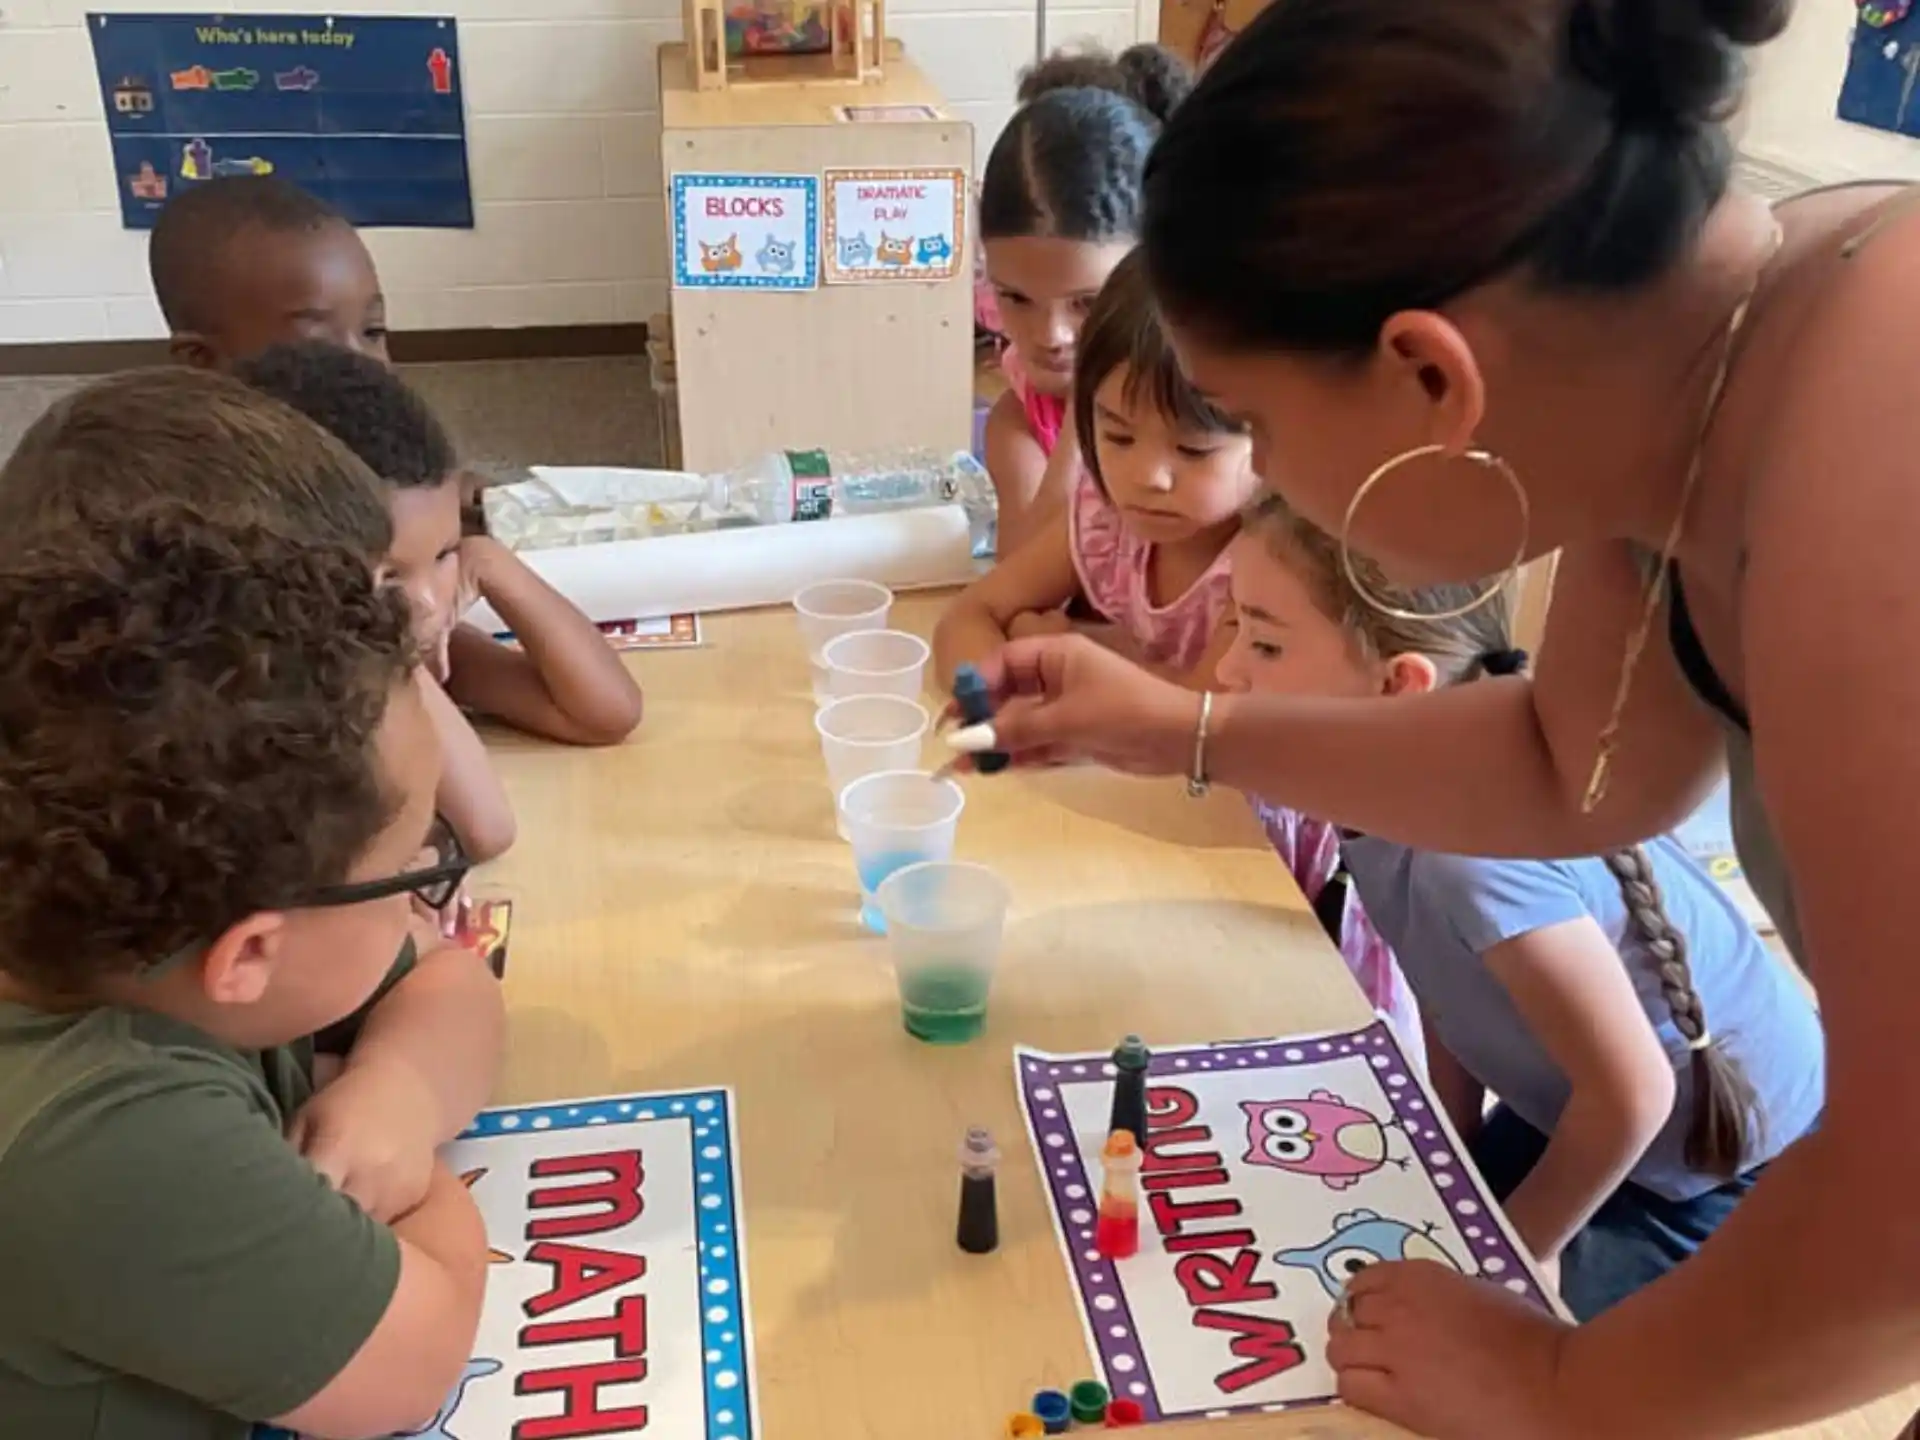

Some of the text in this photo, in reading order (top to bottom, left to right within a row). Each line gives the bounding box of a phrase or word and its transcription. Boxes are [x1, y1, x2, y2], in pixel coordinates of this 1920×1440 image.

[196, 27, 354, 49] Who's here today
[857, 185, 927, 200] DRAMATIC
[705, 196, 784, 218] BLOCKS
[874, 206, 908, 220] PLAY
[1140, 1086, 1306, 1394] WRITING
[511, 1148, 649, 1440] MATH
